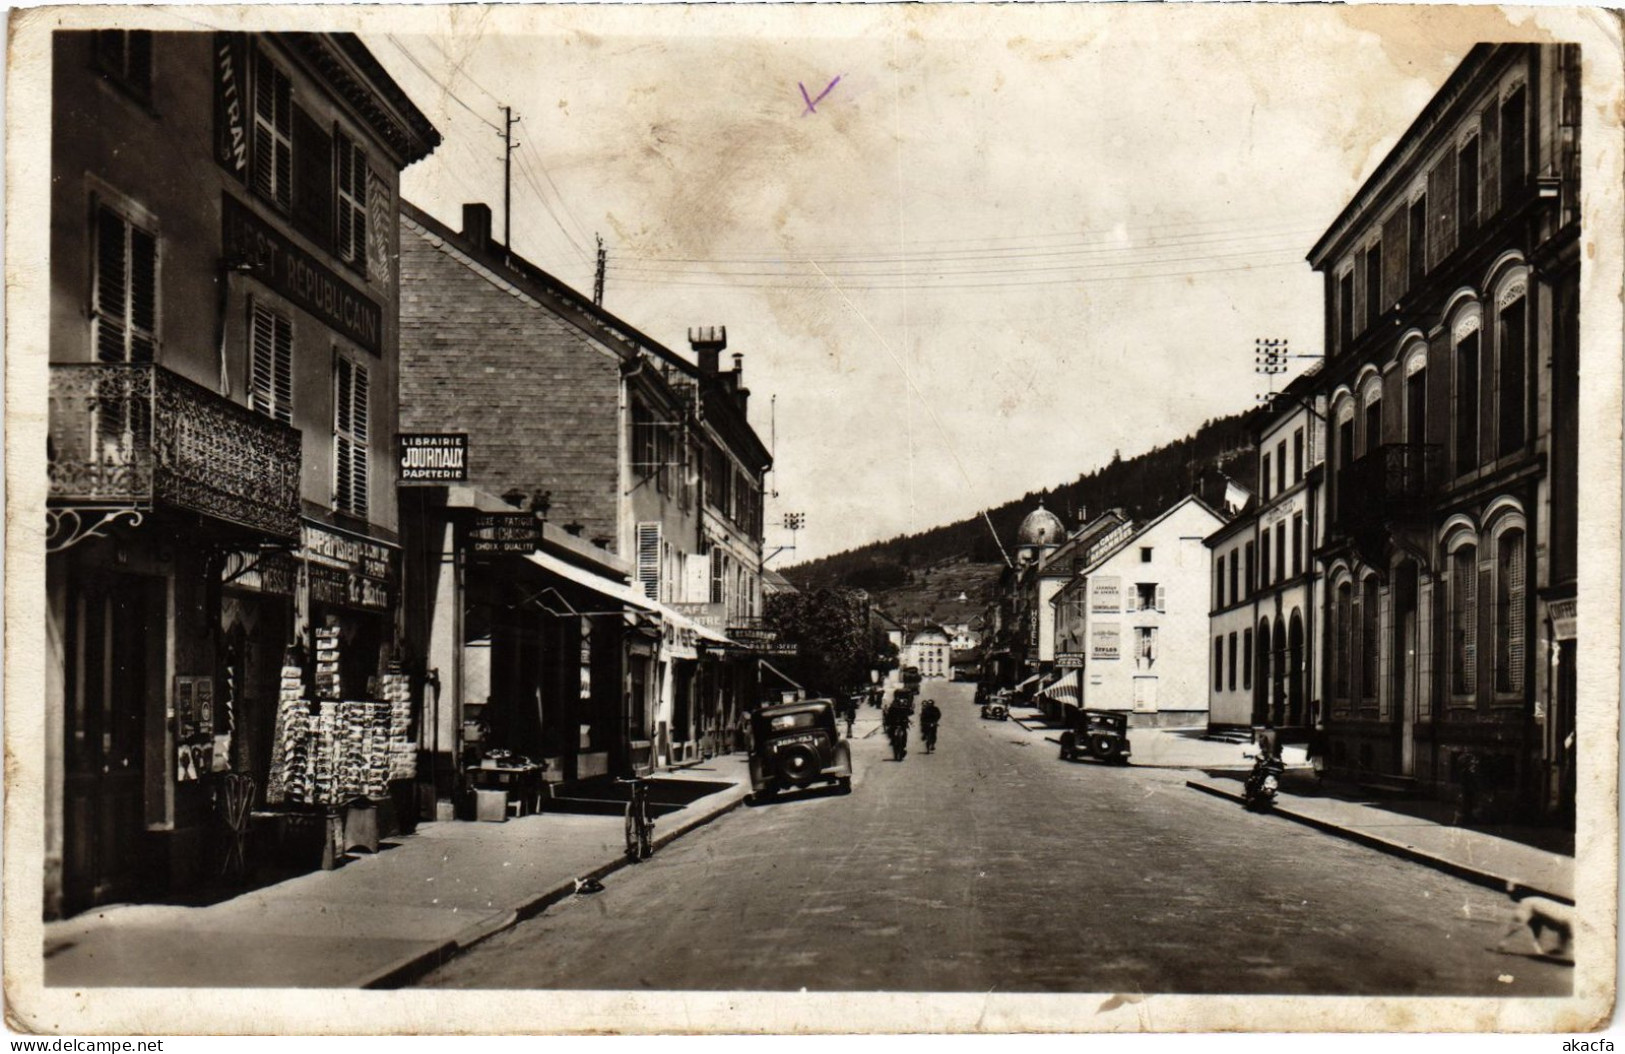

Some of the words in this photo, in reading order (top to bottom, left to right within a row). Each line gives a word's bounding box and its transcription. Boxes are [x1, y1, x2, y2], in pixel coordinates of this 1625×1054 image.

[287, 254, 377, 344] RÉPUBLICAIN
[402, 437, 463, 446] LIBRAIRIE
[401, 447, 464, 469] JOURNAUX
[402, 469, 463, 479] PAPETERIE
[474, 542, 499, 551] CHOIX
